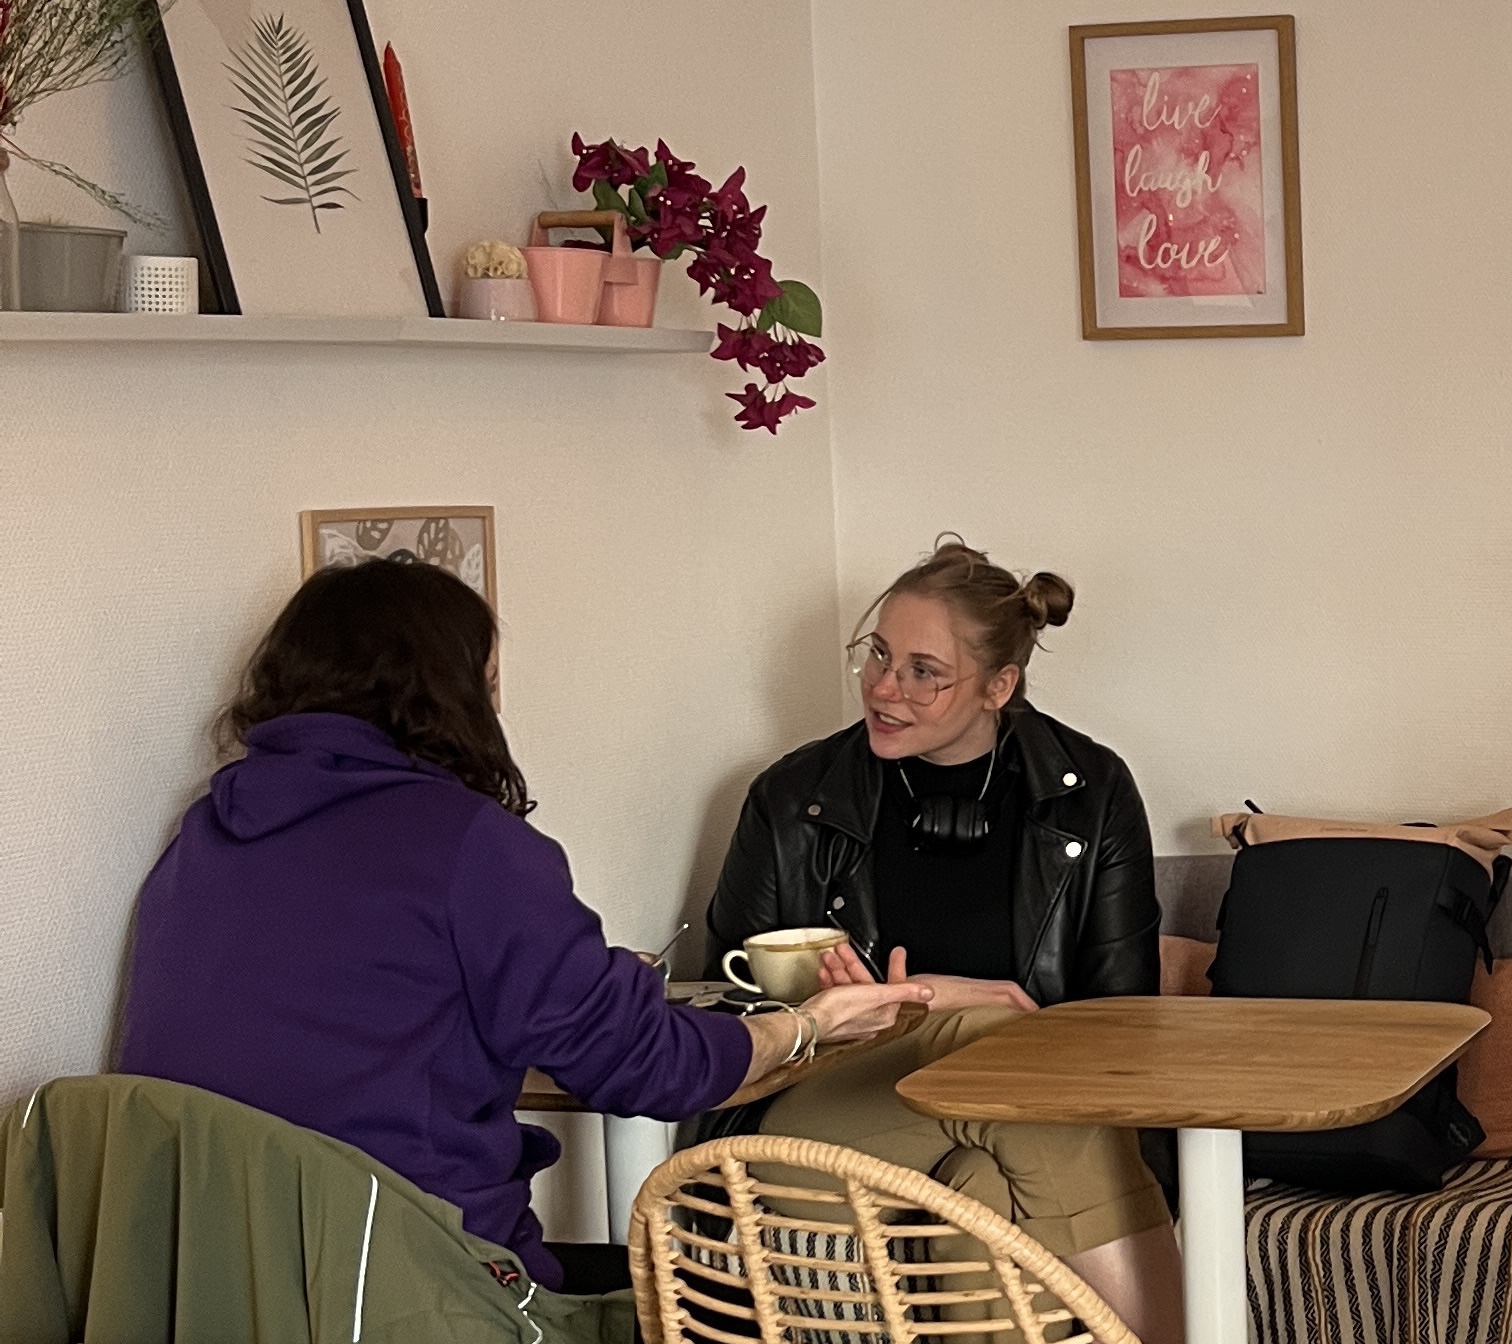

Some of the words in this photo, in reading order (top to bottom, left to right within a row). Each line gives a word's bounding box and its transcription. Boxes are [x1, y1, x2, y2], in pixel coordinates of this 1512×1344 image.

[1143, 72, 1222, 130] live
[1125, 144, 1222, 208] laugh
[1138, 214, 1230, 269] love
